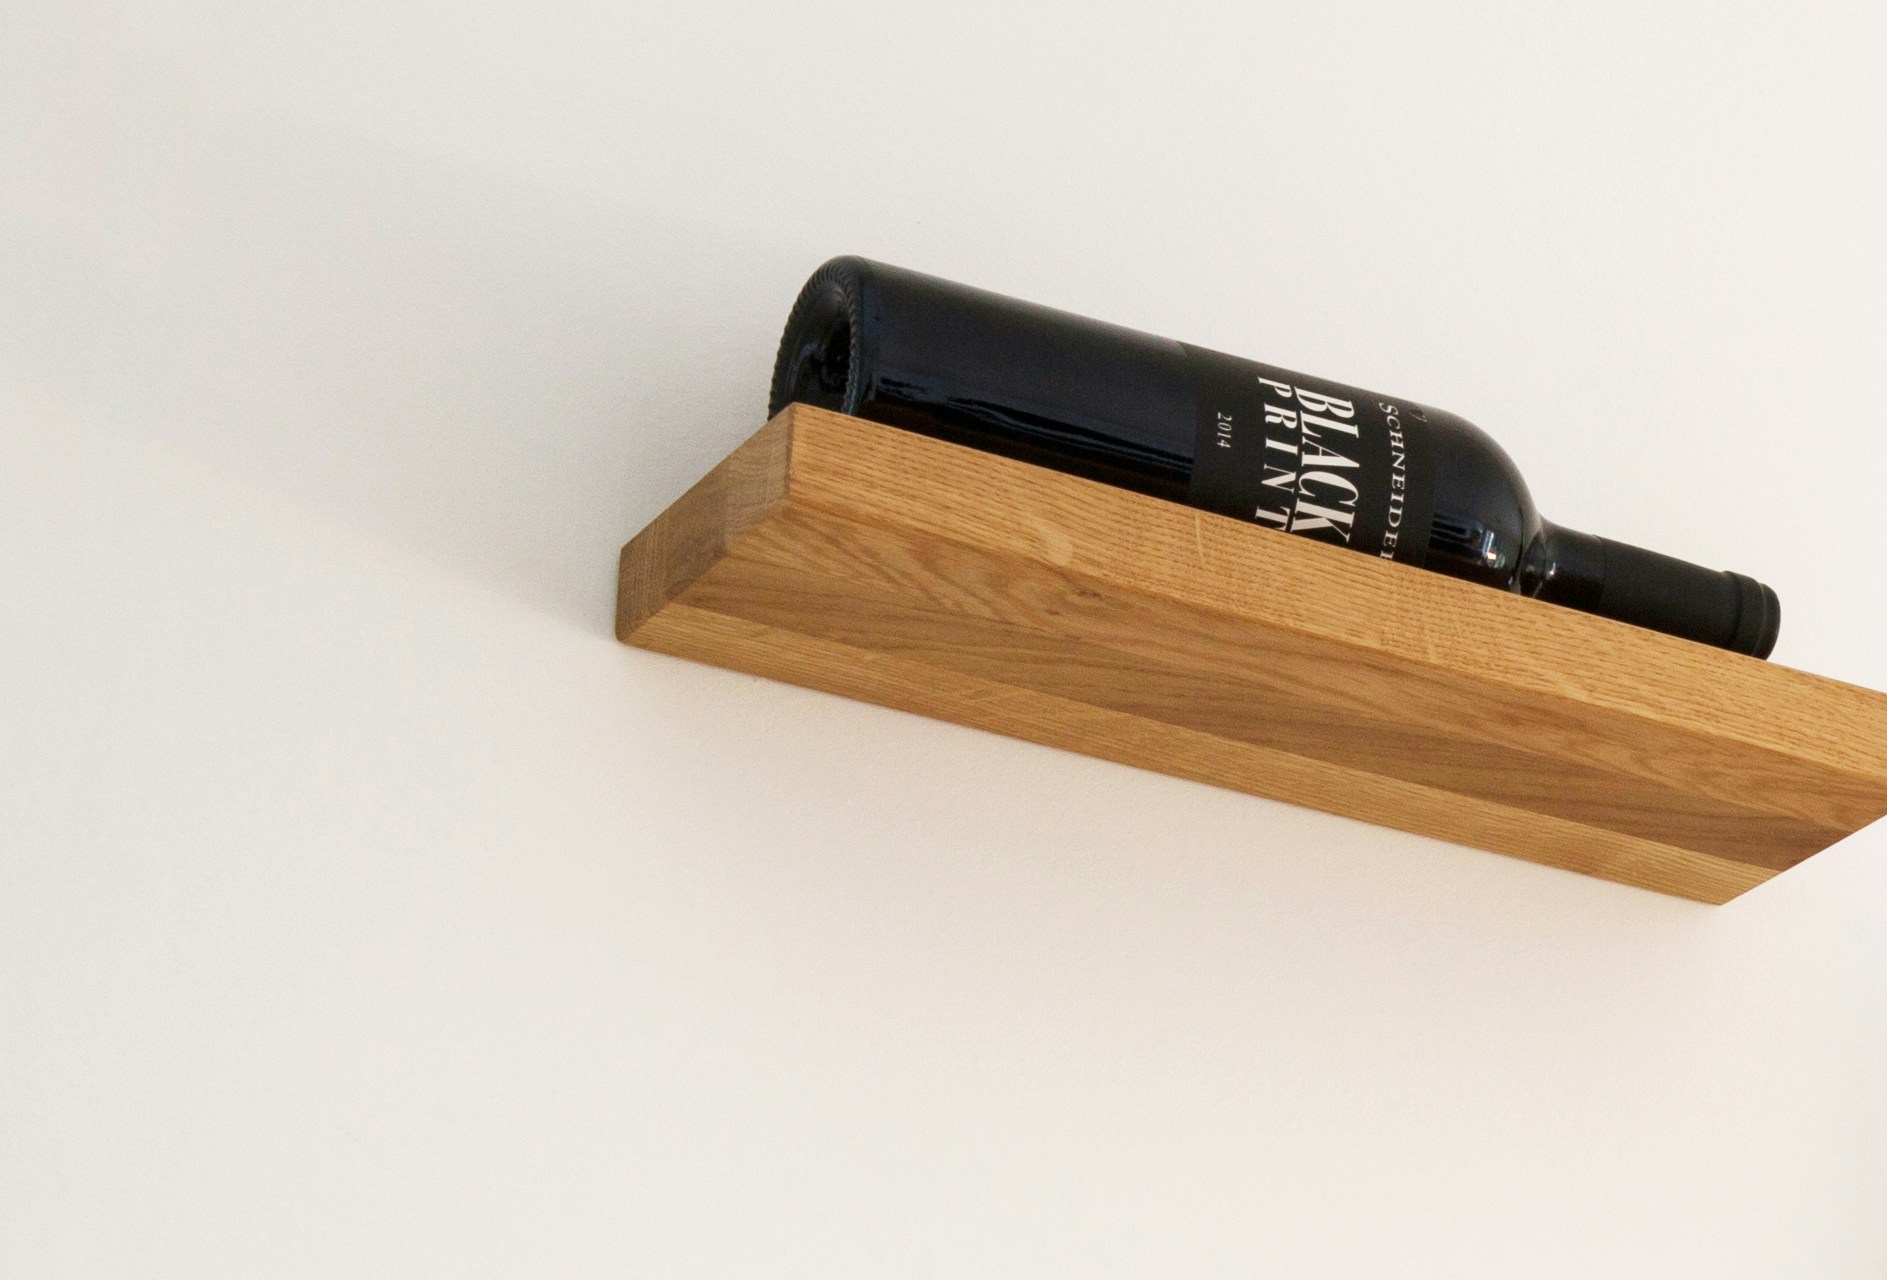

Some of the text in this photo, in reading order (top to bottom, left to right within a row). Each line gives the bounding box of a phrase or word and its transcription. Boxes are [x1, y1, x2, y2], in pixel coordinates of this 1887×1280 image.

[1216, 411, 1233, 449] 2014
[1254, 376, 1299, 531] PRINT
[1290, 386, 1361, 542] BLACK
